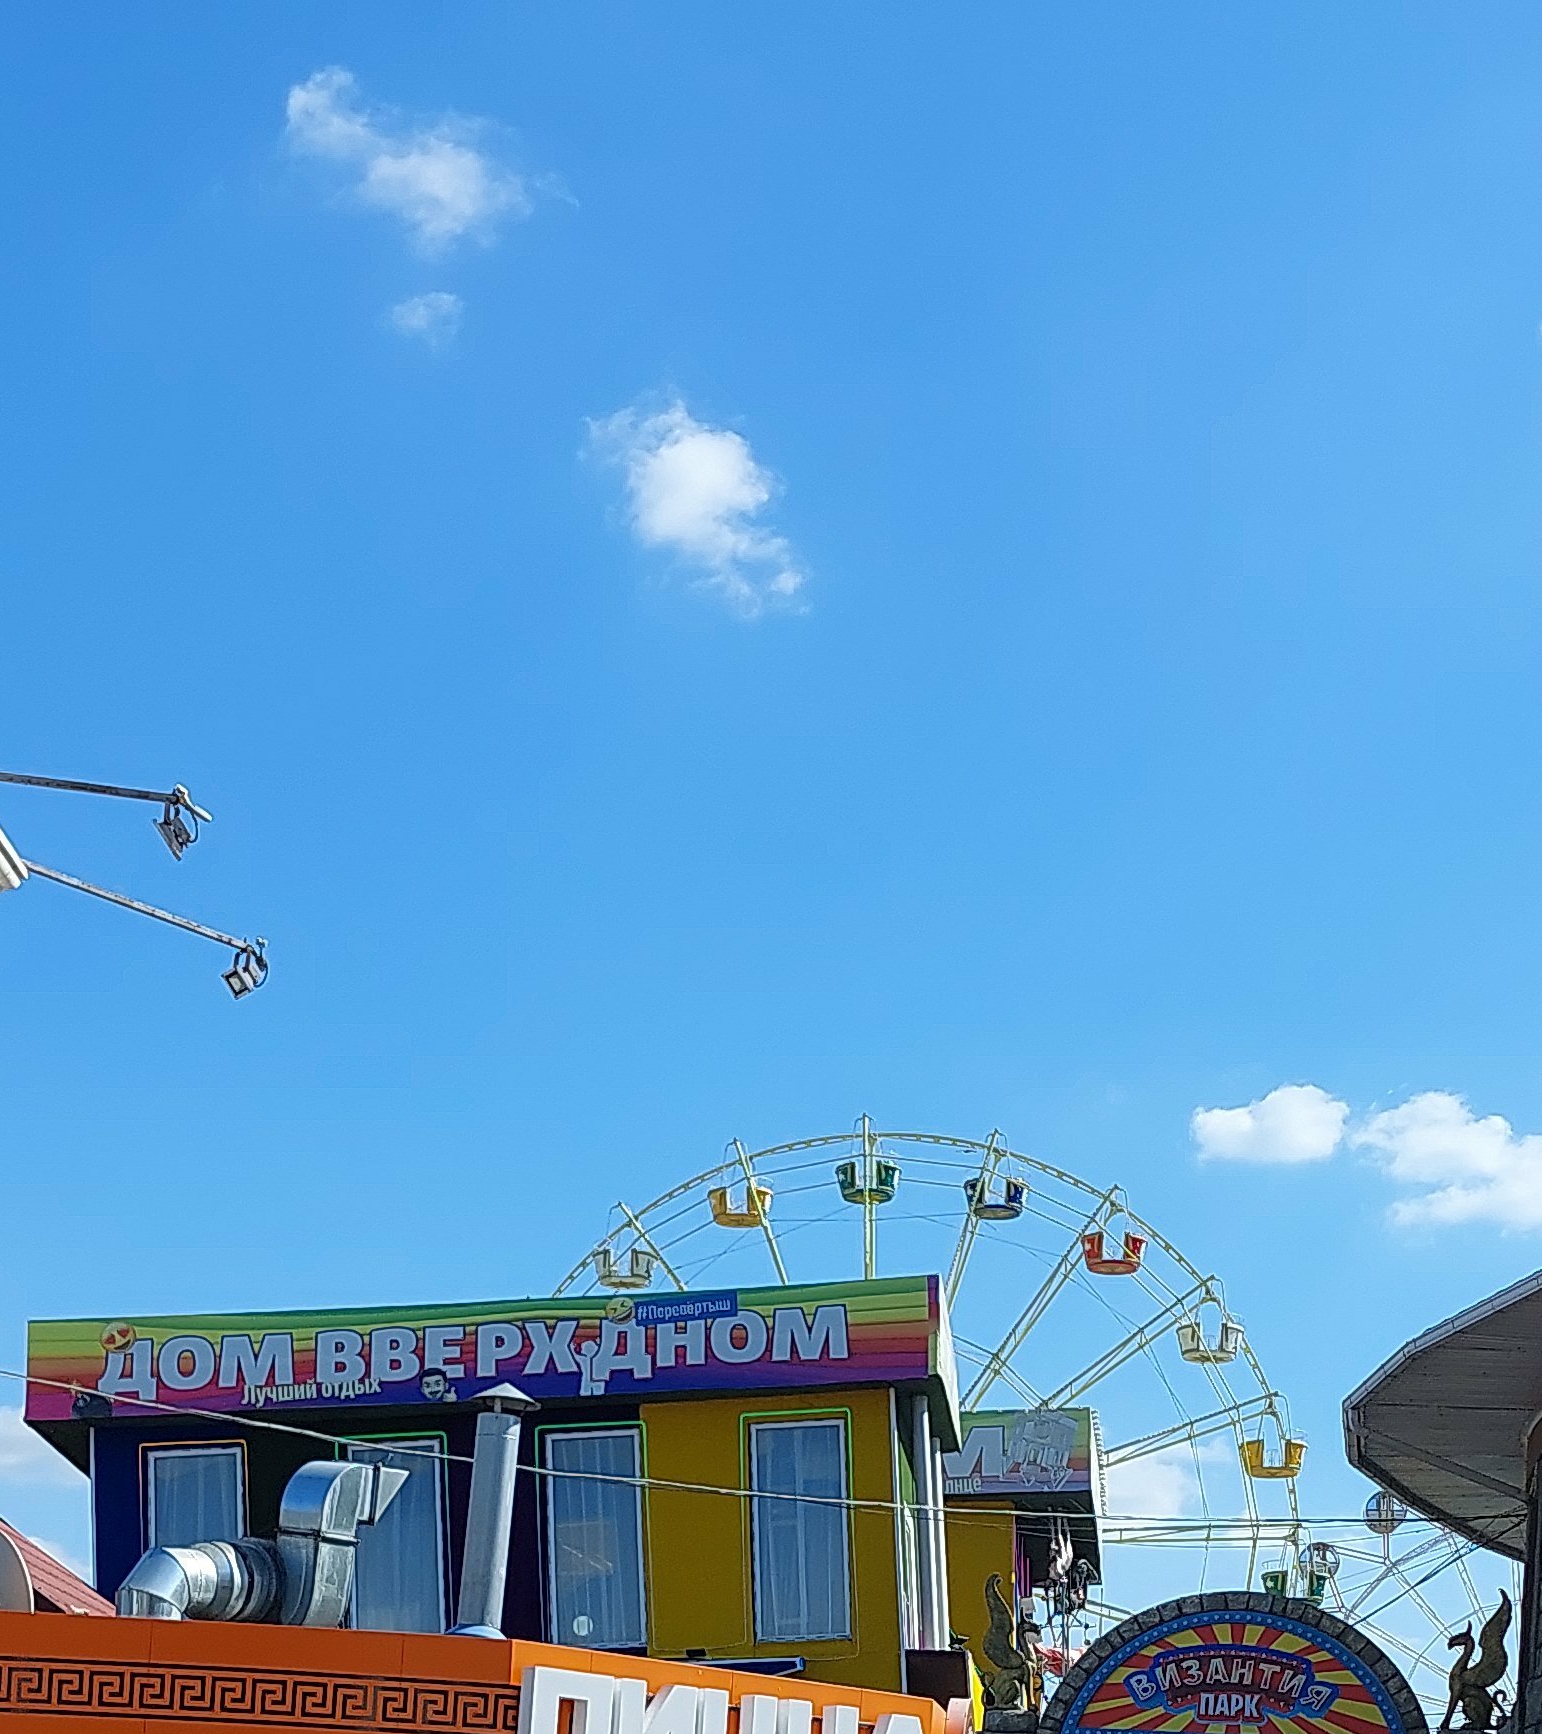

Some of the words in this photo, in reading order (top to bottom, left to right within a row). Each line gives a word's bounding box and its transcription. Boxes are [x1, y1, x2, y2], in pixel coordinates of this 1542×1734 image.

[97, 1331, 295, 1400] ДОМ
[314, 1320, 581, 1384] ВВЕРХ
[589, 1303, 851, 1382] ДНОМ
[241, 1377, 318, 1406] Лучший
[322, 1376, 381, 1399] отдых
[1129, 1656, 1335, 1711] ВИЗАНТИЯ
[1199, 1692, 1263, 1717] ПАРК
